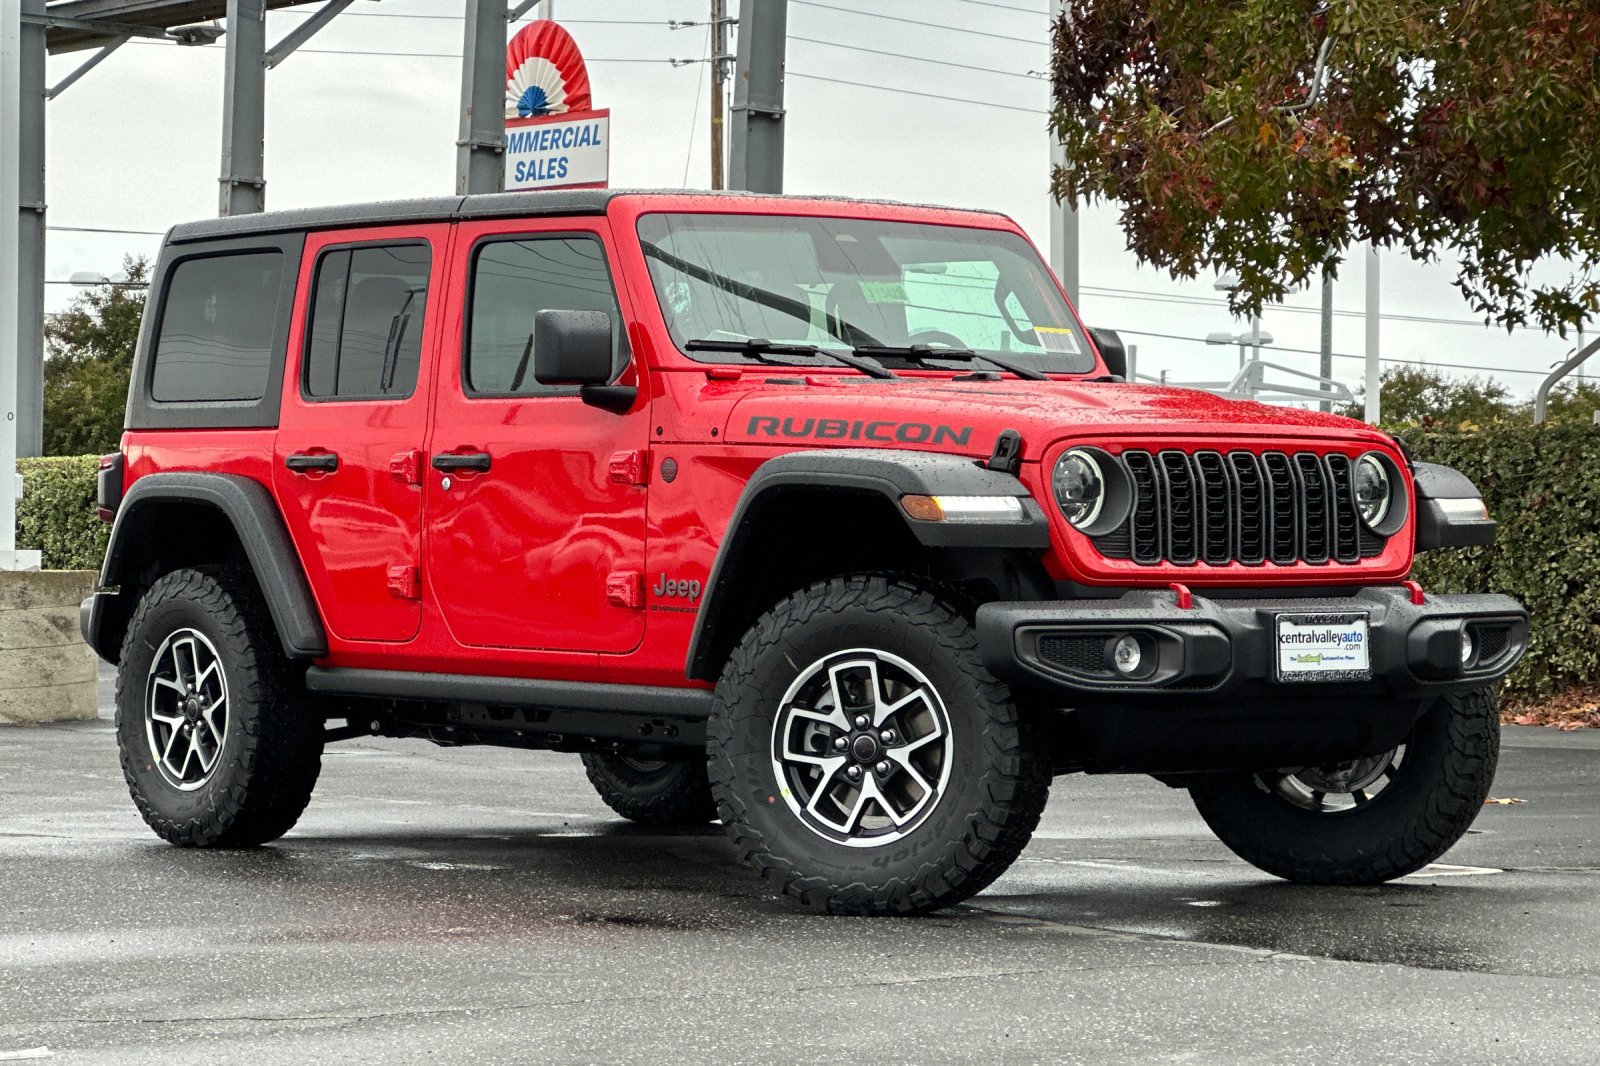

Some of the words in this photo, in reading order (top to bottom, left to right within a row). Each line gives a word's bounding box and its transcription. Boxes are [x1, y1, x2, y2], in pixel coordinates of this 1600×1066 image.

[505, 124, 602, 154] MMERCIAL
[515, 156, 569, 182] SALES
[745, 415, 974, 446] RUBICON
[653, 573, 701, 602] Jeep
[1305, 614, 1345, 624] MODESTO
[1280, 629, 1363, 646] centralvalleyauto
[1343, 643, 1361, 651] .com
